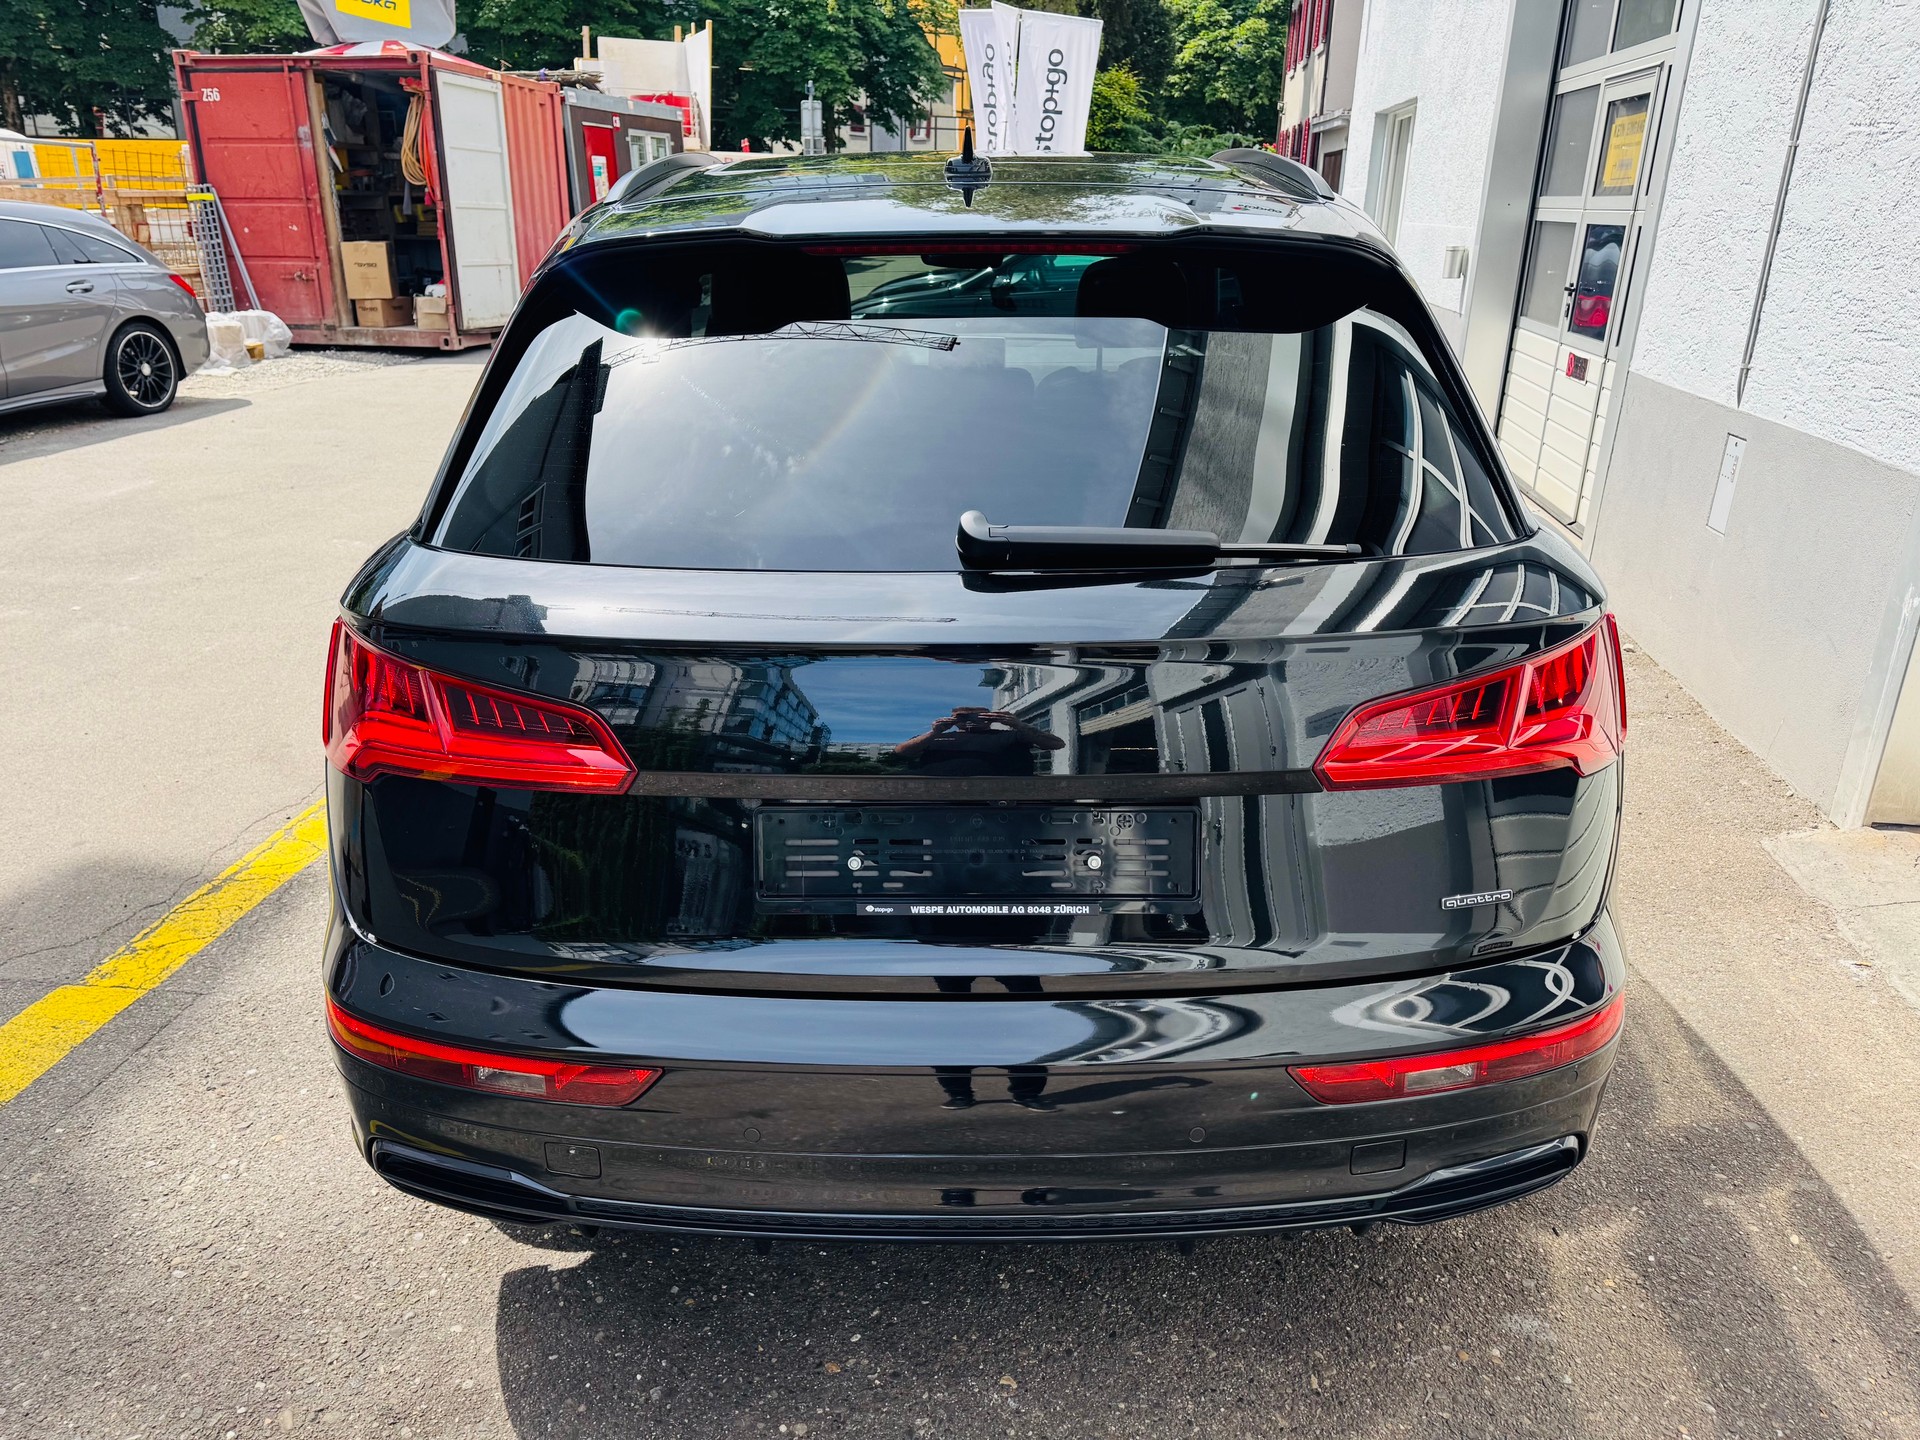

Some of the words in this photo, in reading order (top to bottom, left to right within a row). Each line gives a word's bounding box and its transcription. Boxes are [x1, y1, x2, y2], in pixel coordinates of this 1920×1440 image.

[1446, 893, 1511, 908] quattro
[910, 905, 944, 914] WESPE
[946, 905, 1009, 914] AUTOMOBILE
[1011, 905, 1025, 914] AG
[1027, 905, 1052, 914] 8048
[1053, 904, 1090, 914] ZÜRICH
